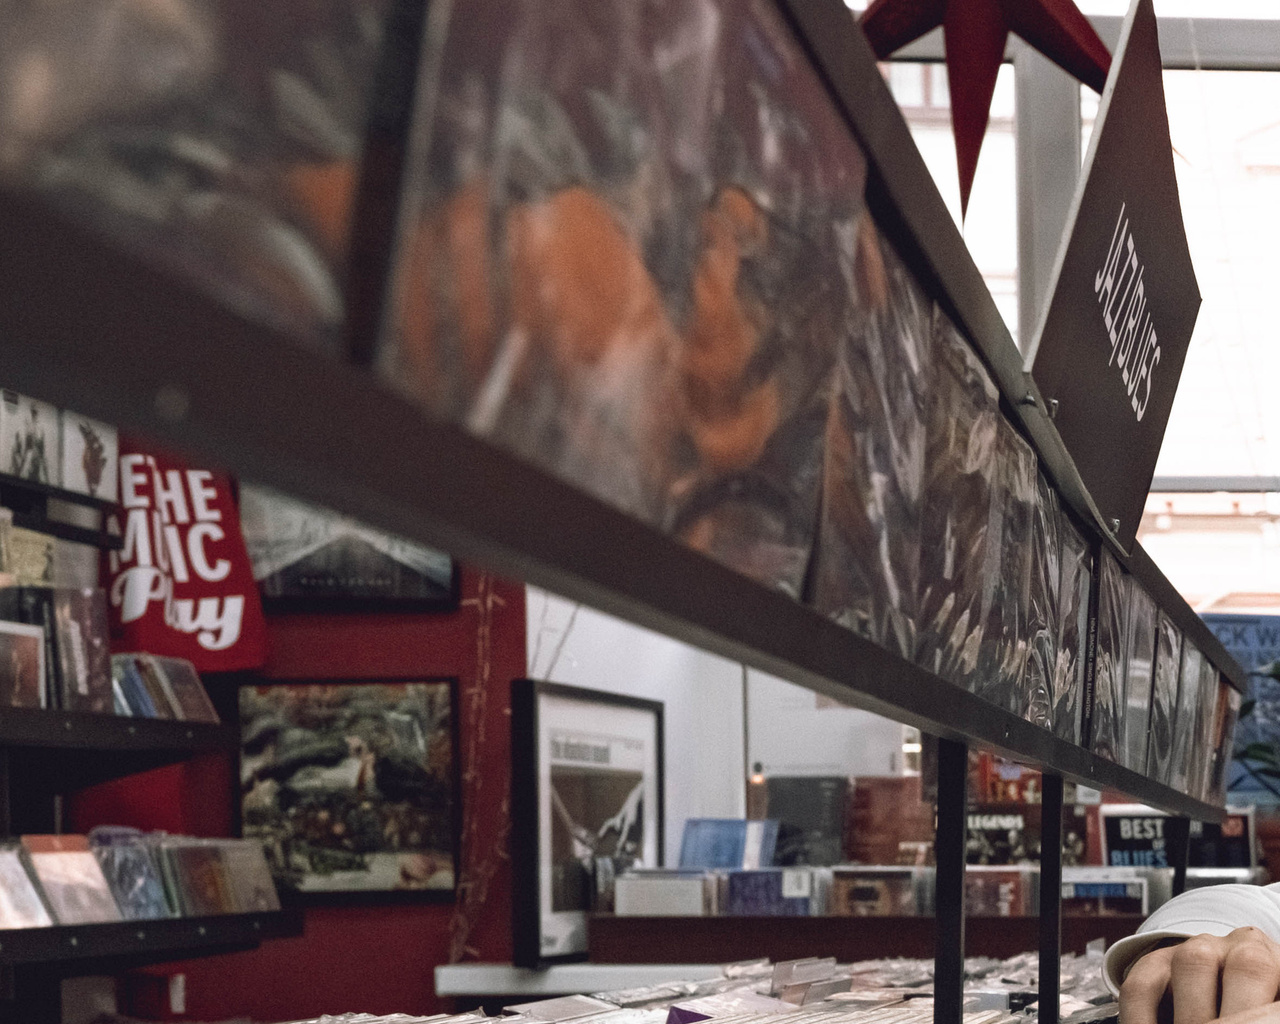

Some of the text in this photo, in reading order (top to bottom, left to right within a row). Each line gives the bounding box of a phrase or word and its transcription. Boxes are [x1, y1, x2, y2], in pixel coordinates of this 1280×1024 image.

[1095, 202, 1161, 422] JAZZ/BLUES
[1214, 626, 1249, 647] CK
[1119, 817, 1166, 840] BEST
[1110, 849, 1169, 868] BLUES
